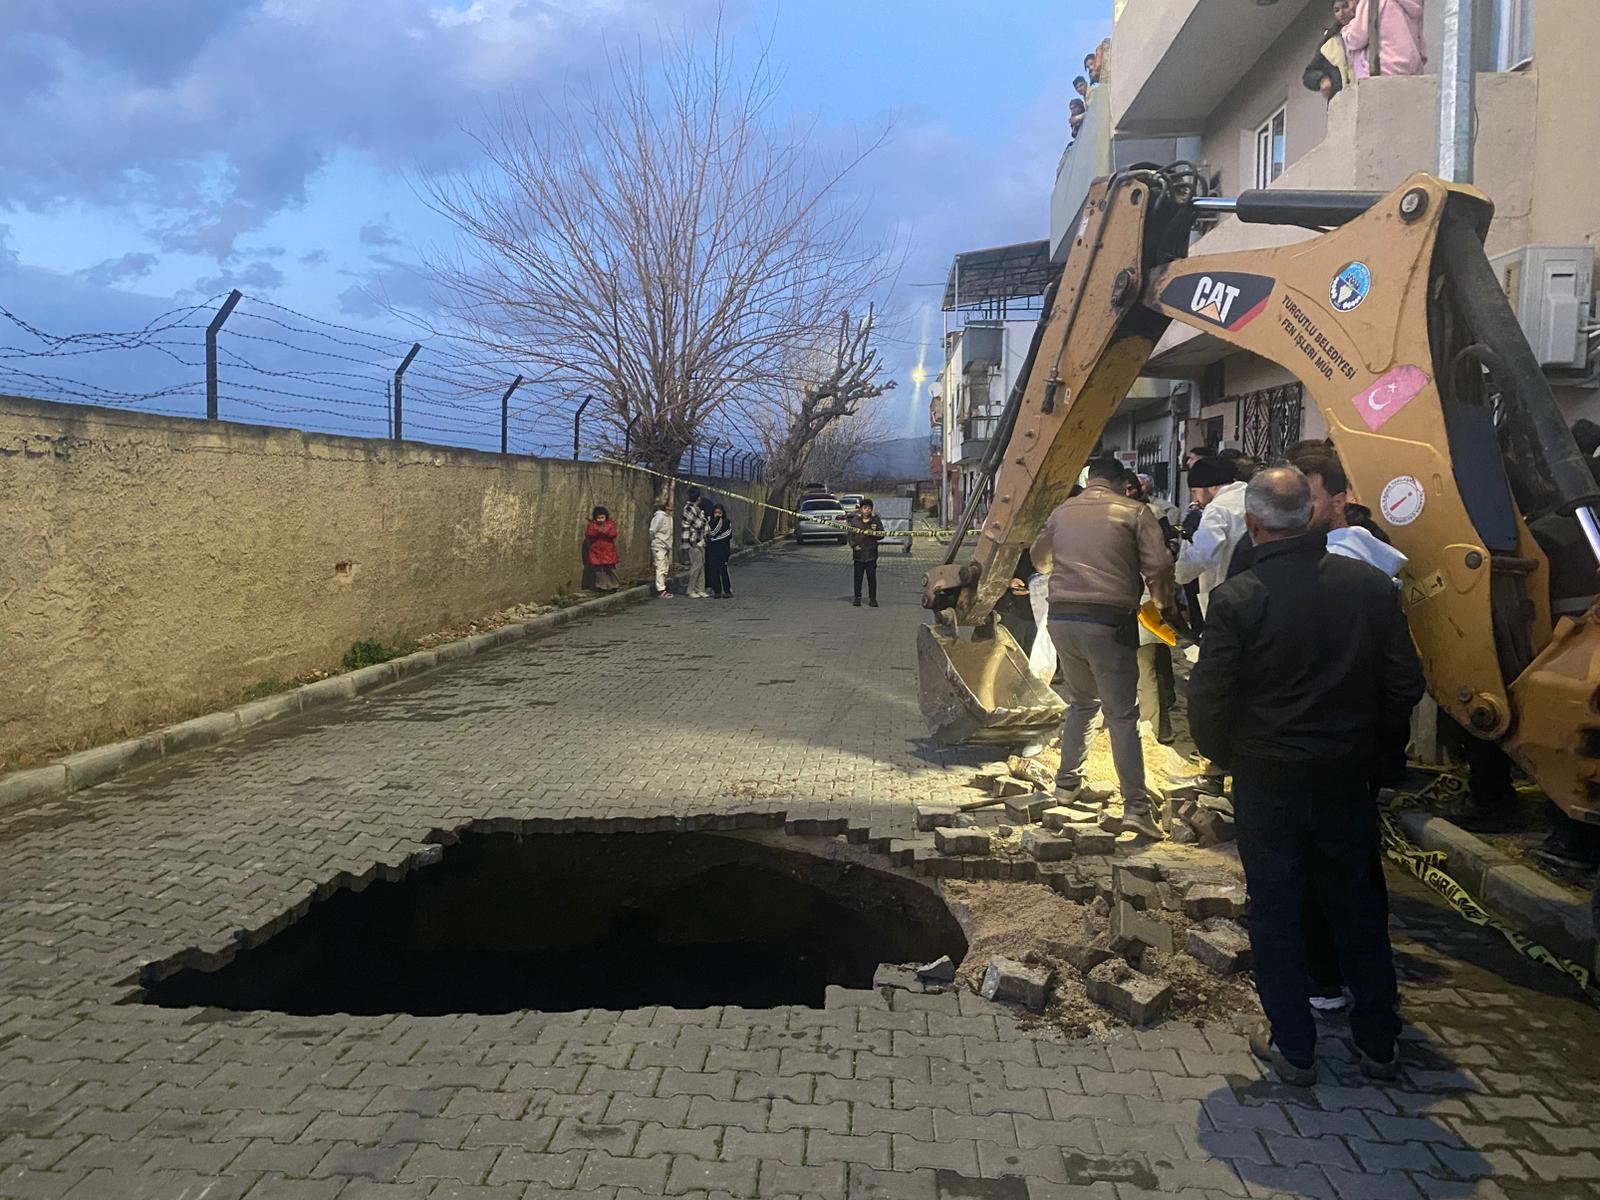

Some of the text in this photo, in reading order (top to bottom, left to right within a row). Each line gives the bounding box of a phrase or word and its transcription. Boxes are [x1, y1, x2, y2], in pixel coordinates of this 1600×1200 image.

[1190, 276, 1240, 323] CAT
[1281, 318, 1334, 381] FEN İŞLERİ MÜD.
[1282, 294, 1317, 336] TURGUTLU
[1314, 332, 1358, 380] BELEDİYESİ
